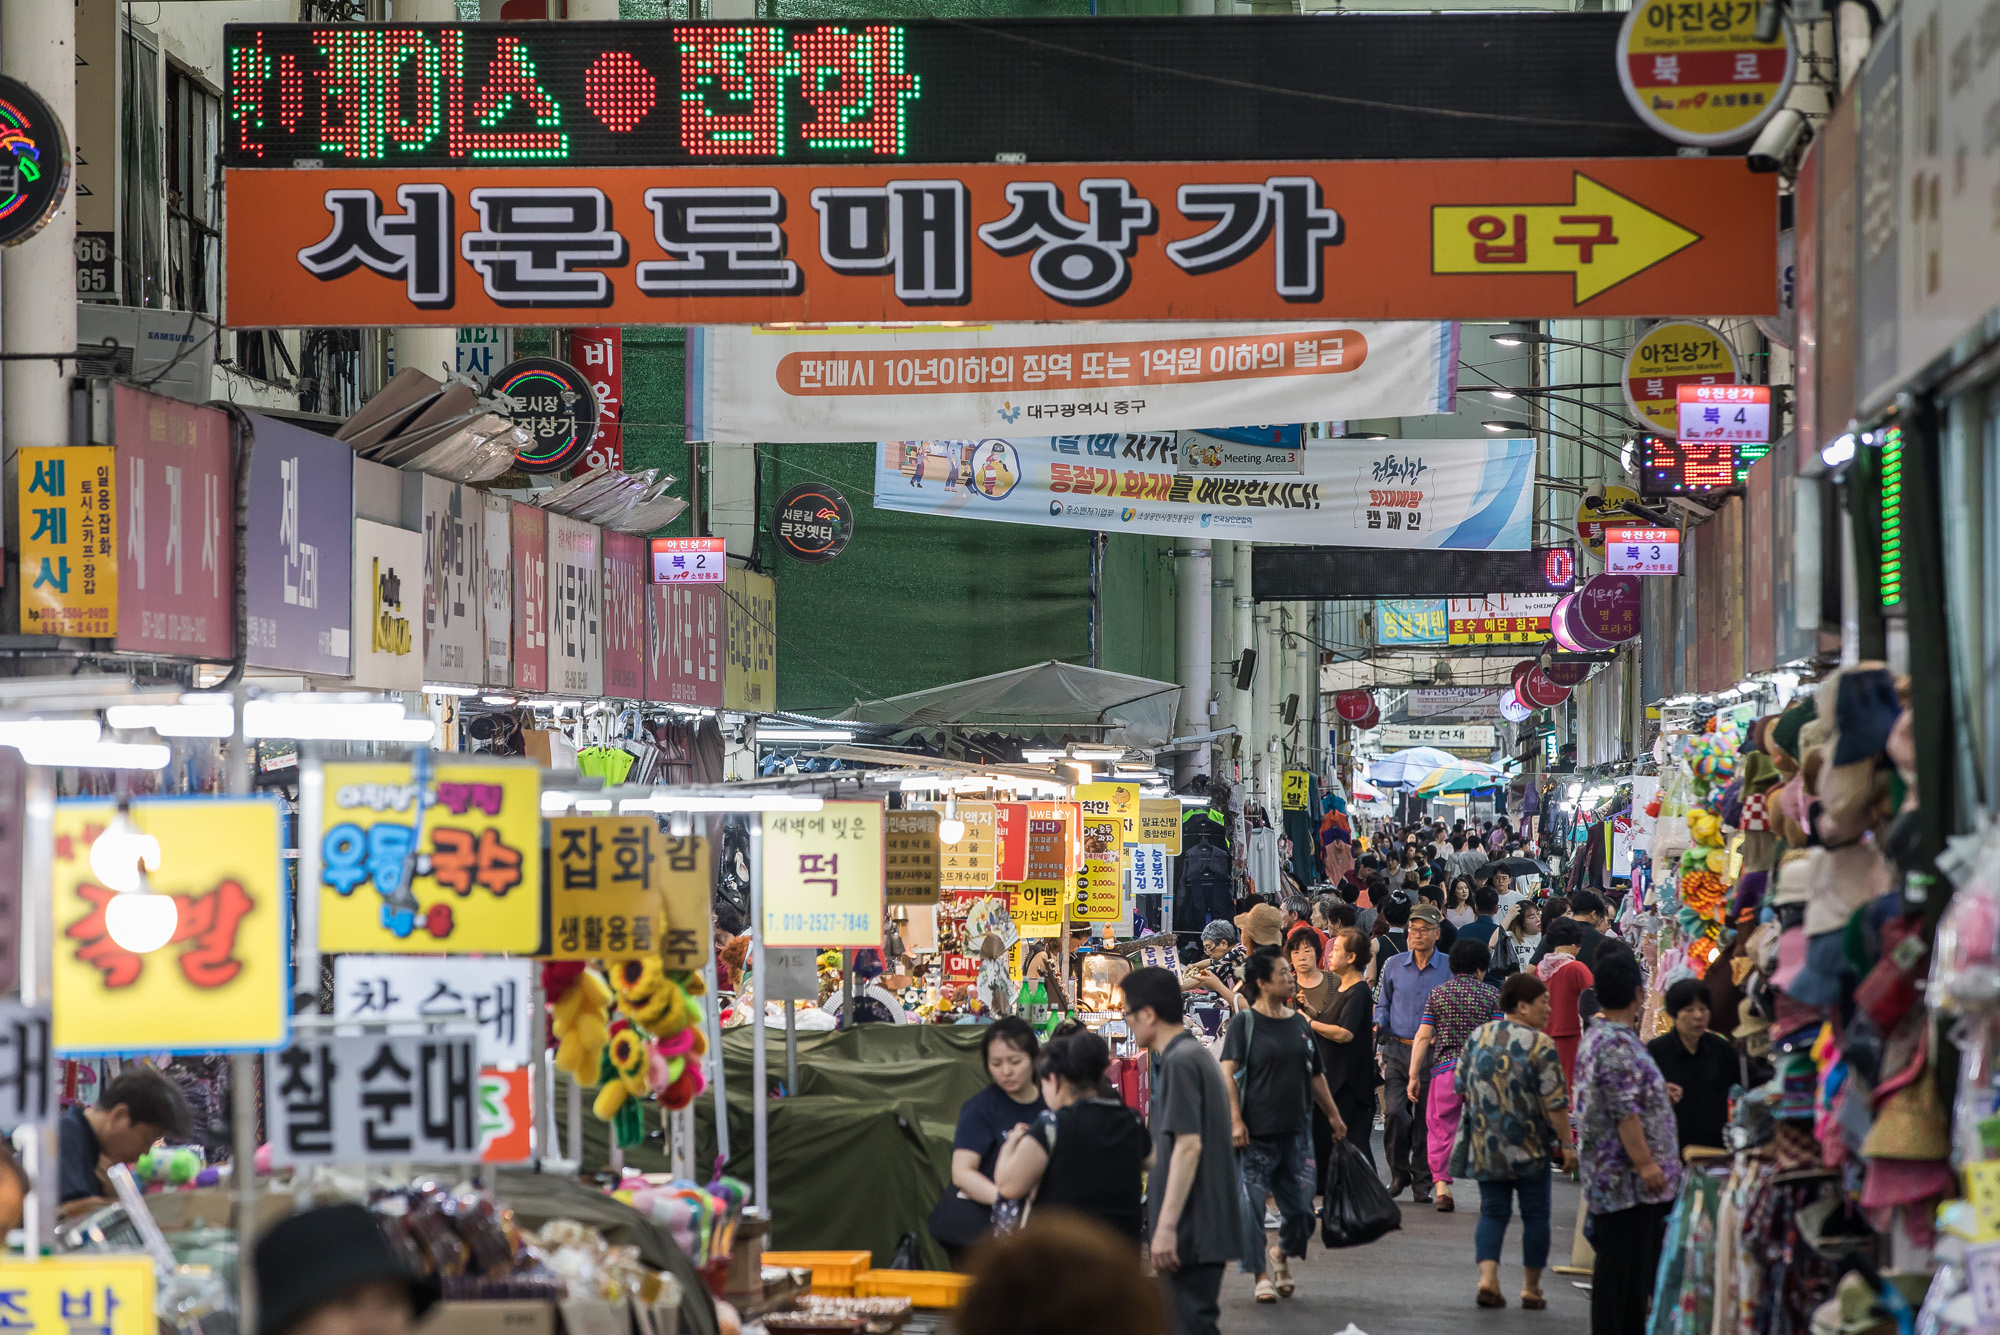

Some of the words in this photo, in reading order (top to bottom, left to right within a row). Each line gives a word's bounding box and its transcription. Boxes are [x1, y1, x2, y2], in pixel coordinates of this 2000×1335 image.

[298, 174, 1344, 308] 서문도매상가
[1466, 213, 1619, 264] 입구
[148, 331, 195, 342] SAMSUNG
[1641, 340, 1719, 364] 아진상가
[800, 359, 873, 388] 판매시
[883, 355, 1014, 387] 10년이하의
[1023, 353, 1072, 382] 징역
[1081, 351, 1131, 379] 또는
[1140, 346, 1202, 377] 1억원
[1210, 341, 1285, 373] 이하의
[1294, 337, 1344, 368] 벌금
[1697, 387, 1755, 399] 아진상가
[1027, 401, 1108, 418] 대구광역시
[1114, 399, 1147, 414] 중구
[1703, 407, 1720, 424] 북
[1734, 407, 1747, 424] 4
[507, 416, 577, 438] 진상가
[1224, 453, 1264, 465] Meeting
[1265, 453, 1287, 464] Area
[1288, 452, 1296, 463] 3
[1050, 462, 1116, 497] 동절기
[1120, 472, 1193, 503] 화재를
[1368, 489, 1424, 508] 화재예방
[782, 508, 813, 522] 서문길
[1066, 505, 1115, 517] 중소벤처기업부
[1367, 510, 1422, 531] 캠페인
[28, 459, 72, 593] 세계사
[127, 456, 220, 598] 세계사
[780, 522, 832, 541] 큰장옛터
[1622, 530, 1667, 540] 아진상가
[668, 540, 711, 548] 아진상가
[1626, 546, 1640, 560] 북
[1650, 546, 1661, 560] 3
[672, 555, 685, 569] 북
[696, 555, 706, 568] 2
[1644, 563, 1674, 571] 소방통로
[554, 562, 598, 663] 서문장식
[604, 557, 635, 651] 중앙상사
[1484, 618, 1509, 632] 예단
[1515, 617, 1539, 631] 침구
[1600, 623, 1632, 635] 프라자
[697, 593, 717, 682] 신발
[1286, 773, 1305, 812] 가발
[1141, 817, 1178, 828] 말표신발
[558, 824, 656, 891] 잡화
[799, 853, 838, 897] 떡
[1030, 911, 1058, 921] 삽니다
[276, 1038, 474, 1153] 찰순대
